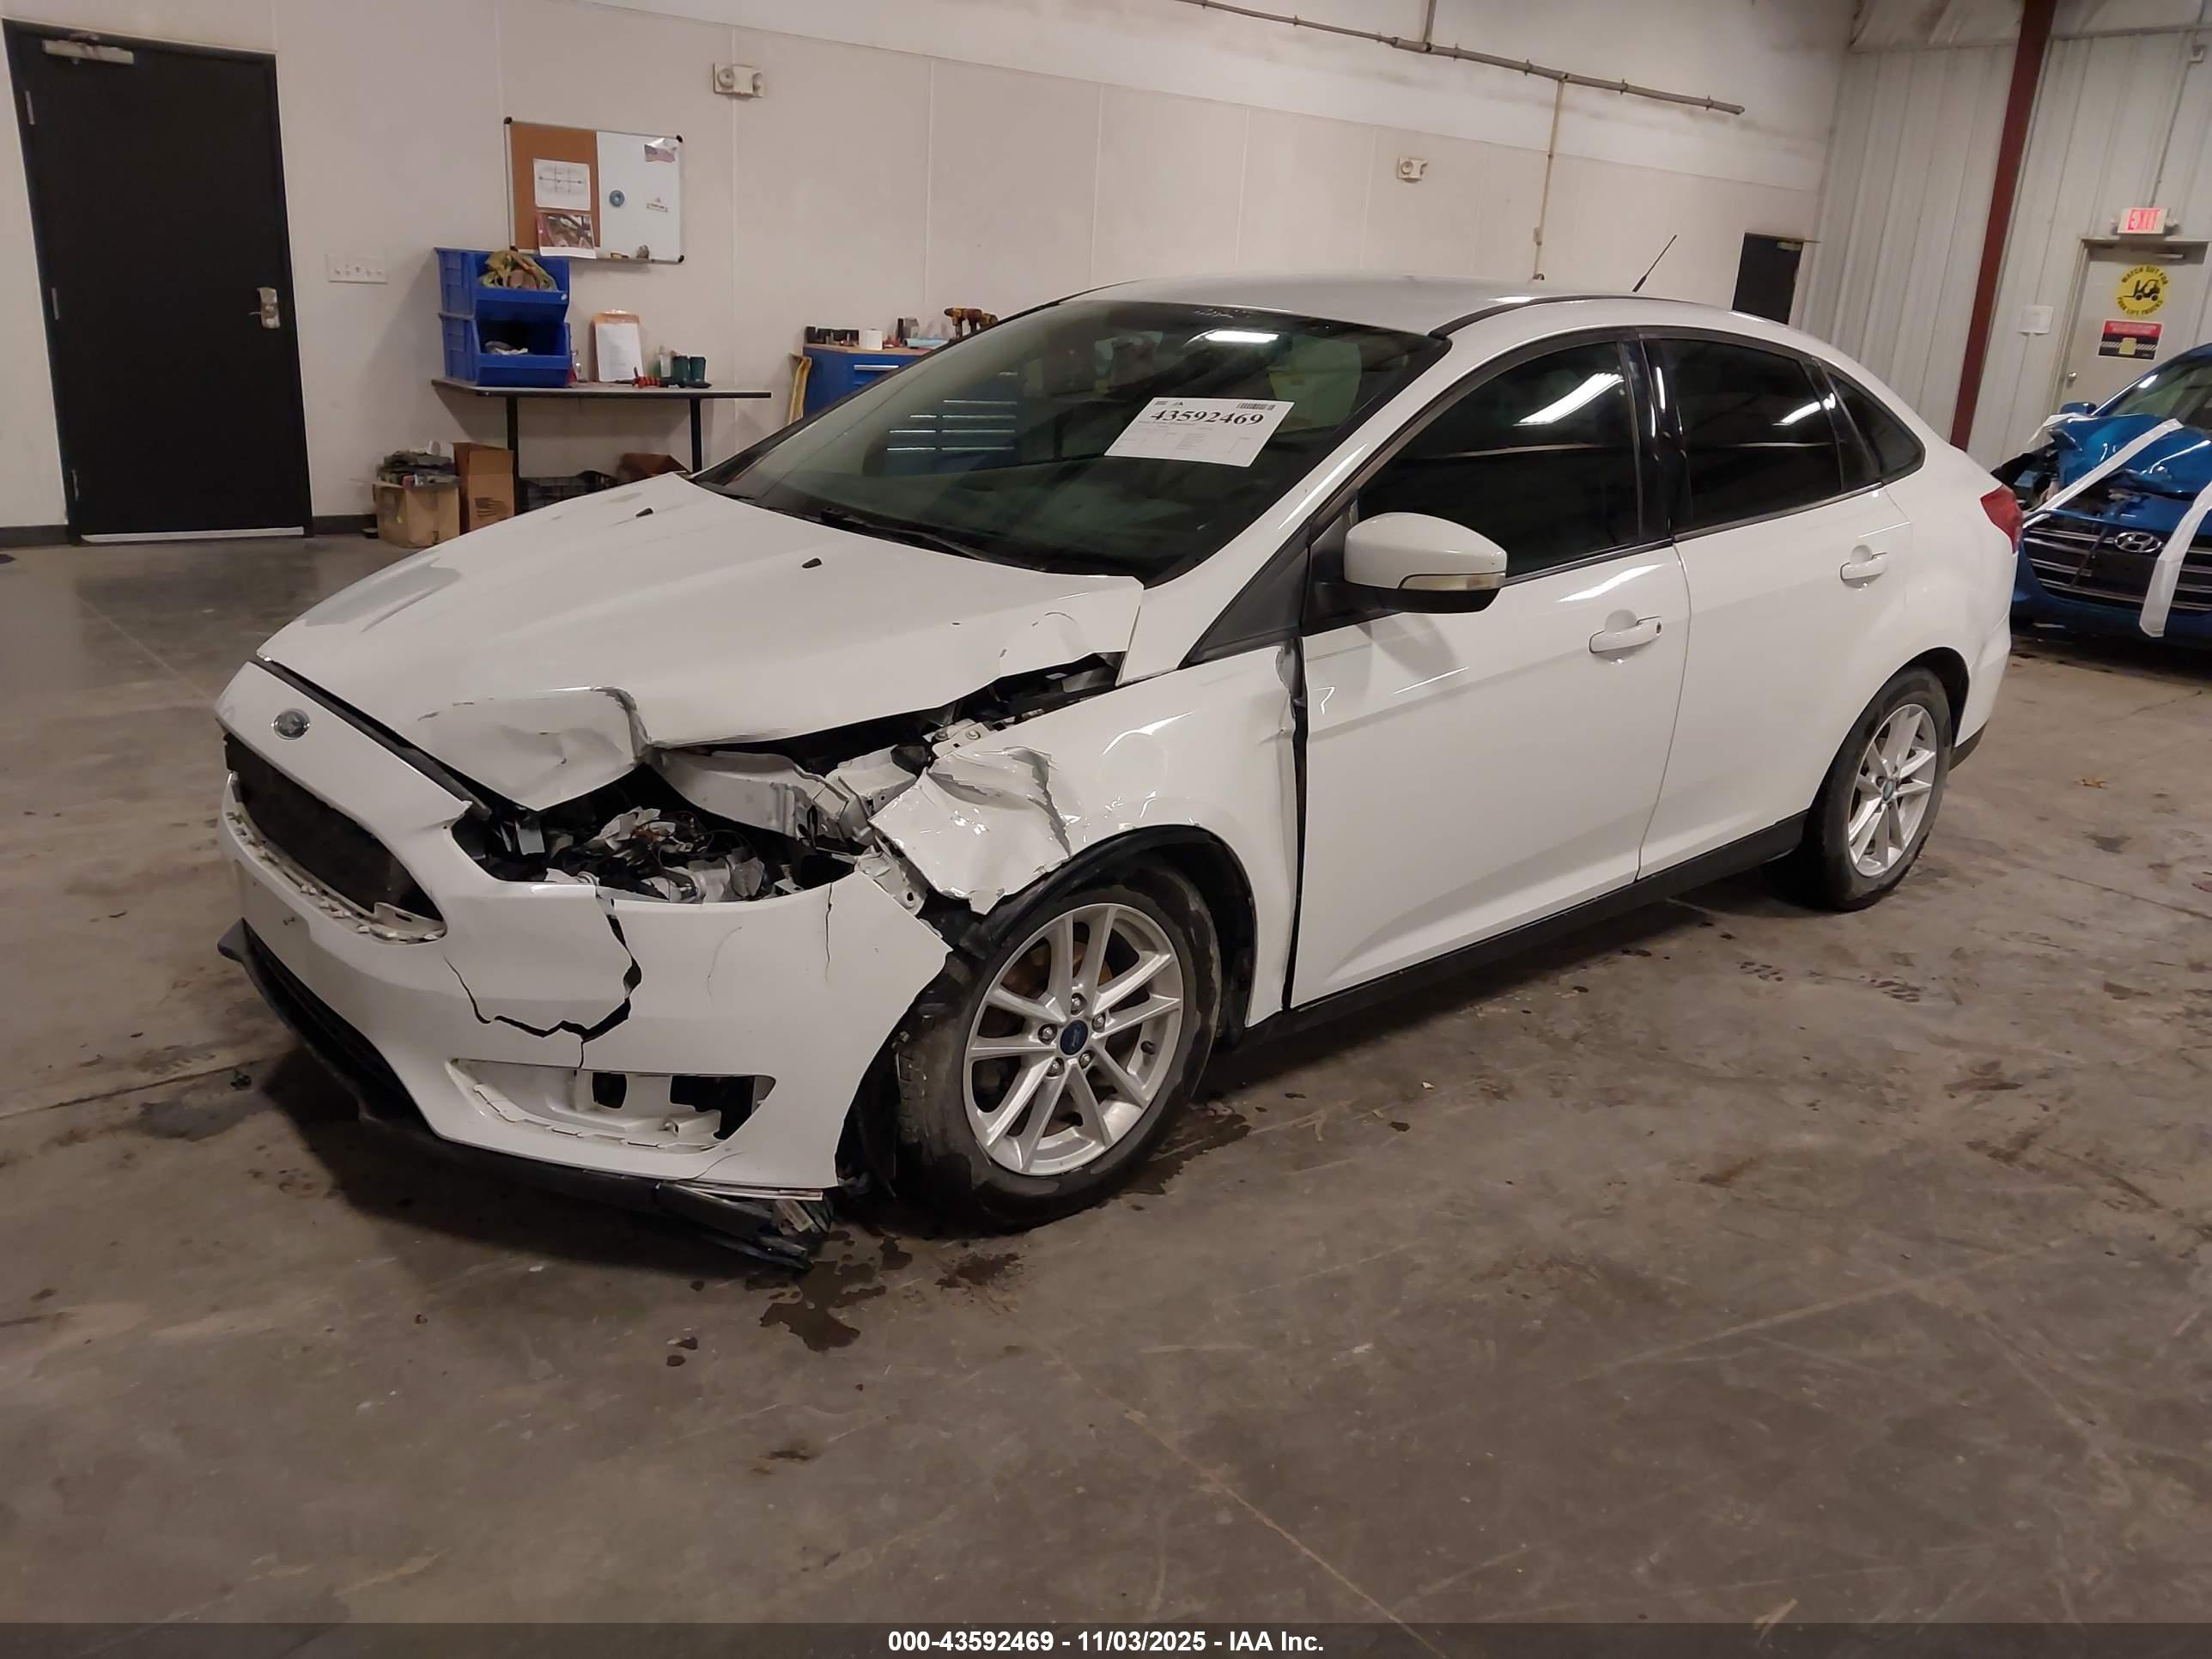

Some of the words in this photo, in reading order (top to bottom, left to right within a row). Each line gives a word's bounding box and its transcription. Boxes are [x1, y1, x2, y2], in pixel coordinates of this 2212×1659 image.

[2128, 209, 2160, 231] EXIT
[2121, 266, 2144, 283] WATCH
[2146, 265, 2160, 274] OUT
[2158, 272, 2169, 285] FOR
[2117, 297, 2128, 311] FORK
[2141, 301, 2164, 315] TRUCKS
[1150, 410, 1265, 426] 43592469
